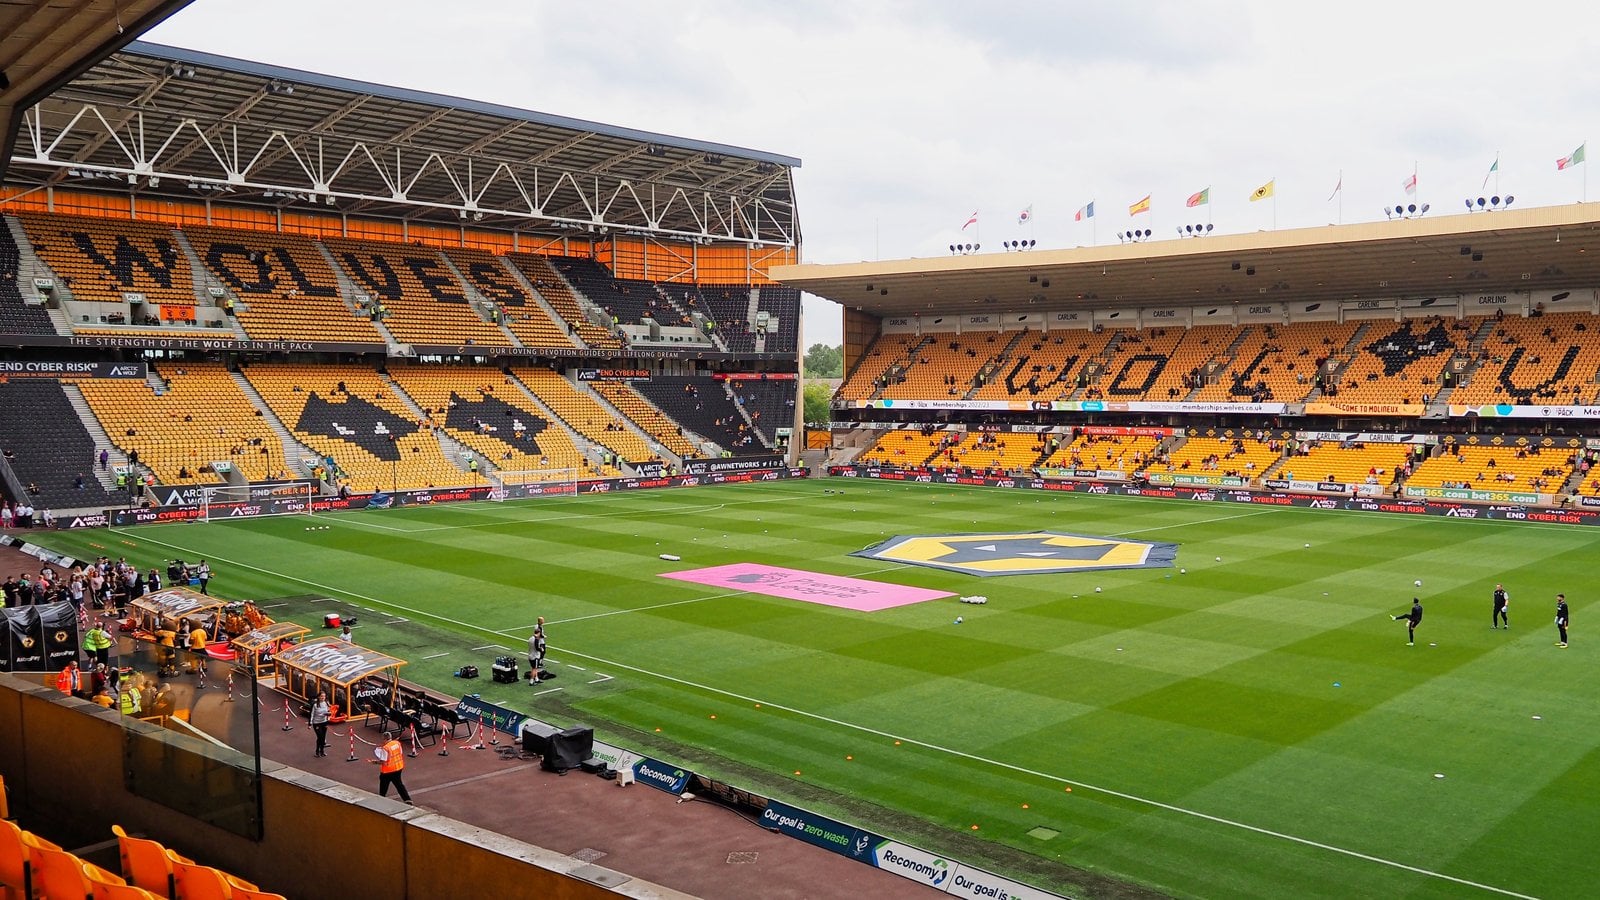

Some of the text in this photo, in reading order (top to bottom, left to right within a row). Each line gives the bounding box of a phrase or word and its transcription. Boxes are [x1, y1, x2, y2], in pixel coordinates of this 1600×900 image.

[1358, 300, 1380, 308] CARLING
[1479, 296, 1507, 304] CARLING
[96, 338, 155, 347] STRENGTH
[0, 362, 23, 371] END
[26, 363, 63, 371] CYBER
[1330, 402, 1359, 413] WELCOME
[710, 461, 760, 472] @AWNETWORKS
[1194, 477, 1241, 486] bet365.com
[183, 488, 216, 497] ARCTIC
[1408, 488, 1536, 503] bet365.com bet365.com
[50, 650, 75, 658] AstroPay
[356, 686, 389, 698] AstroPay
[459, 702, 468, 710] Our
[600, 752, 616, 764] waste
[639, 764, 678, 787] Reconomy
[764, 808, 849, 846] Our goal is zero waste
[883, 850, 938, 880] Reconomy
[955, 875, 1008, 900] Our goal is
